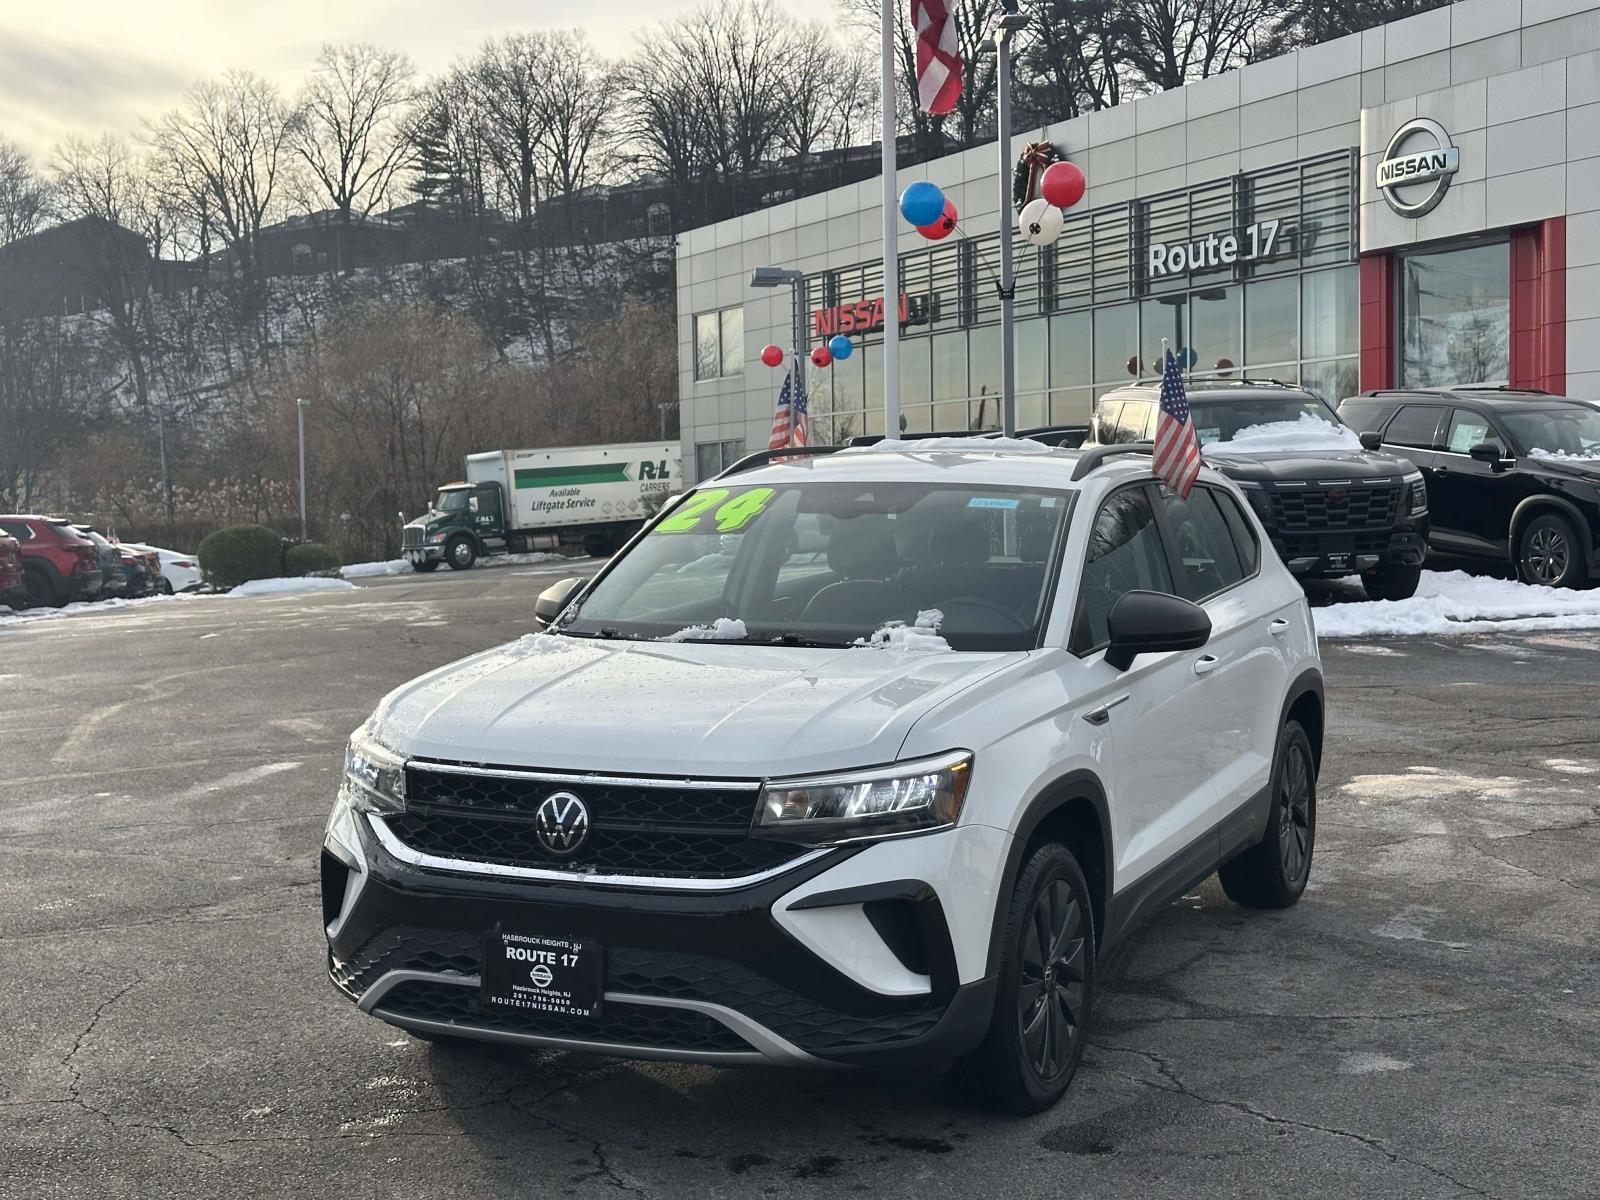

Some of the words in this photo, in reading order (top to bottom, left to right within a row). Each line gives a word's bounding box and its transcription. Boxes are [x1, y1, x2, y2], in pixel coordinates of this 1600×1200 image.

[1381, 154, 1447, 182] NISSAN
[1149, 232, 1238, 276] Route
[1246, 219, 1280, 259] 17
[815, 291, 908, 336] NISSAN
[549, 488, 581, 498] Available
[640, 482, 671, 493] CARRIERS
[531, 499, 565, 514] Liftgate
[566, 497, 596, 508] Service
[654, 487, 775, 534] 24
[502, 933, 541, 945] HASBROUCK
[573, 943, 582, 951] NJ
[506, 947, 556, 965] ROUTE
[561, 953, 579, 967] 17
[532, 972, 551, 980] NISSAN
[512, 984, 540, 993] Hasbrouck
[491, 996, 590, 1016] ROUTE17NISSAN.COM
